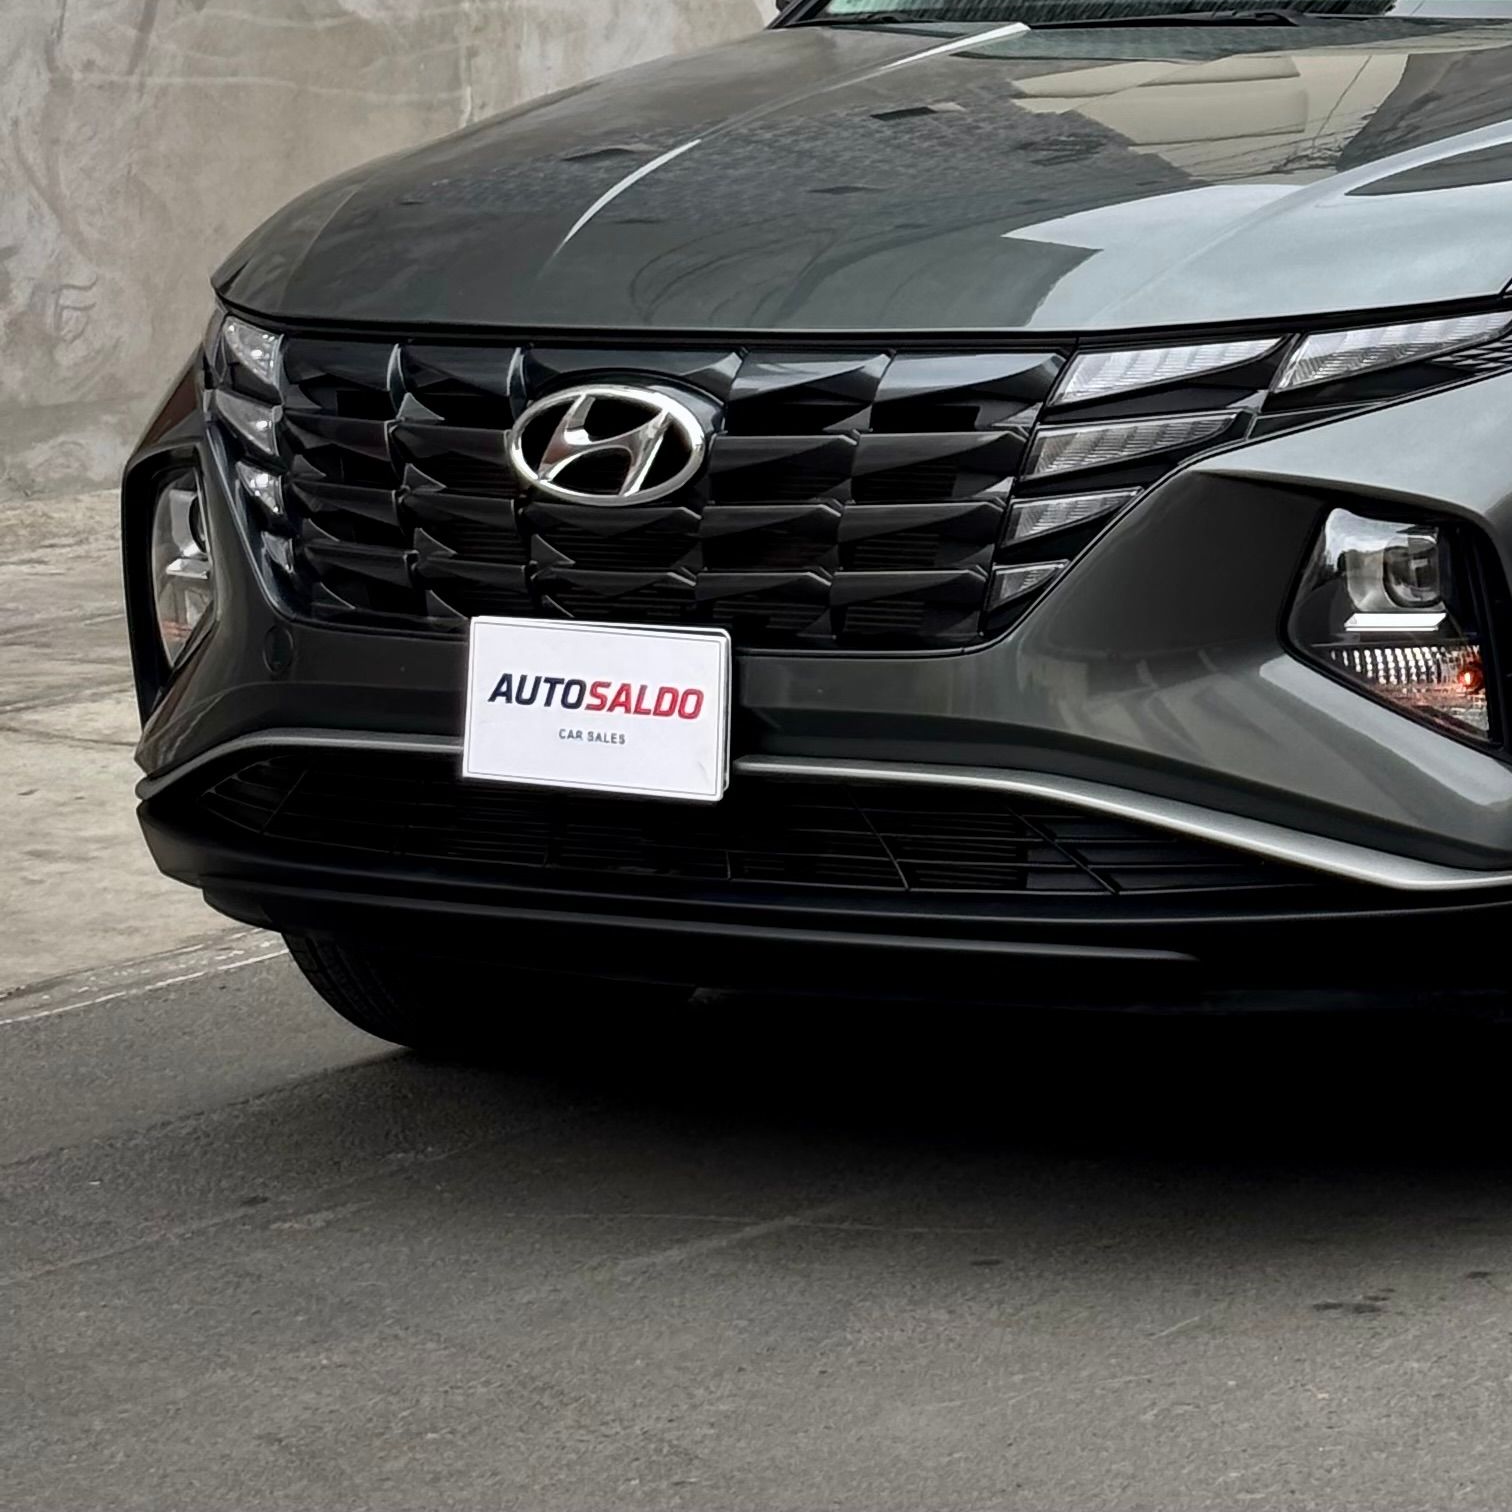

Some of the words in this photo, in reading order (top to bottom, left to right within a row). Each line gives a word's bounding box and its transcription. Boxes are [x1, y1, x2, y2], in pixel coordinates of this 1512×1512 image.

[487, 673, 705, 720] AUTOSALDO
[558, 728, 584, 742] CAR
[587, 730, 626, 745] SALES
